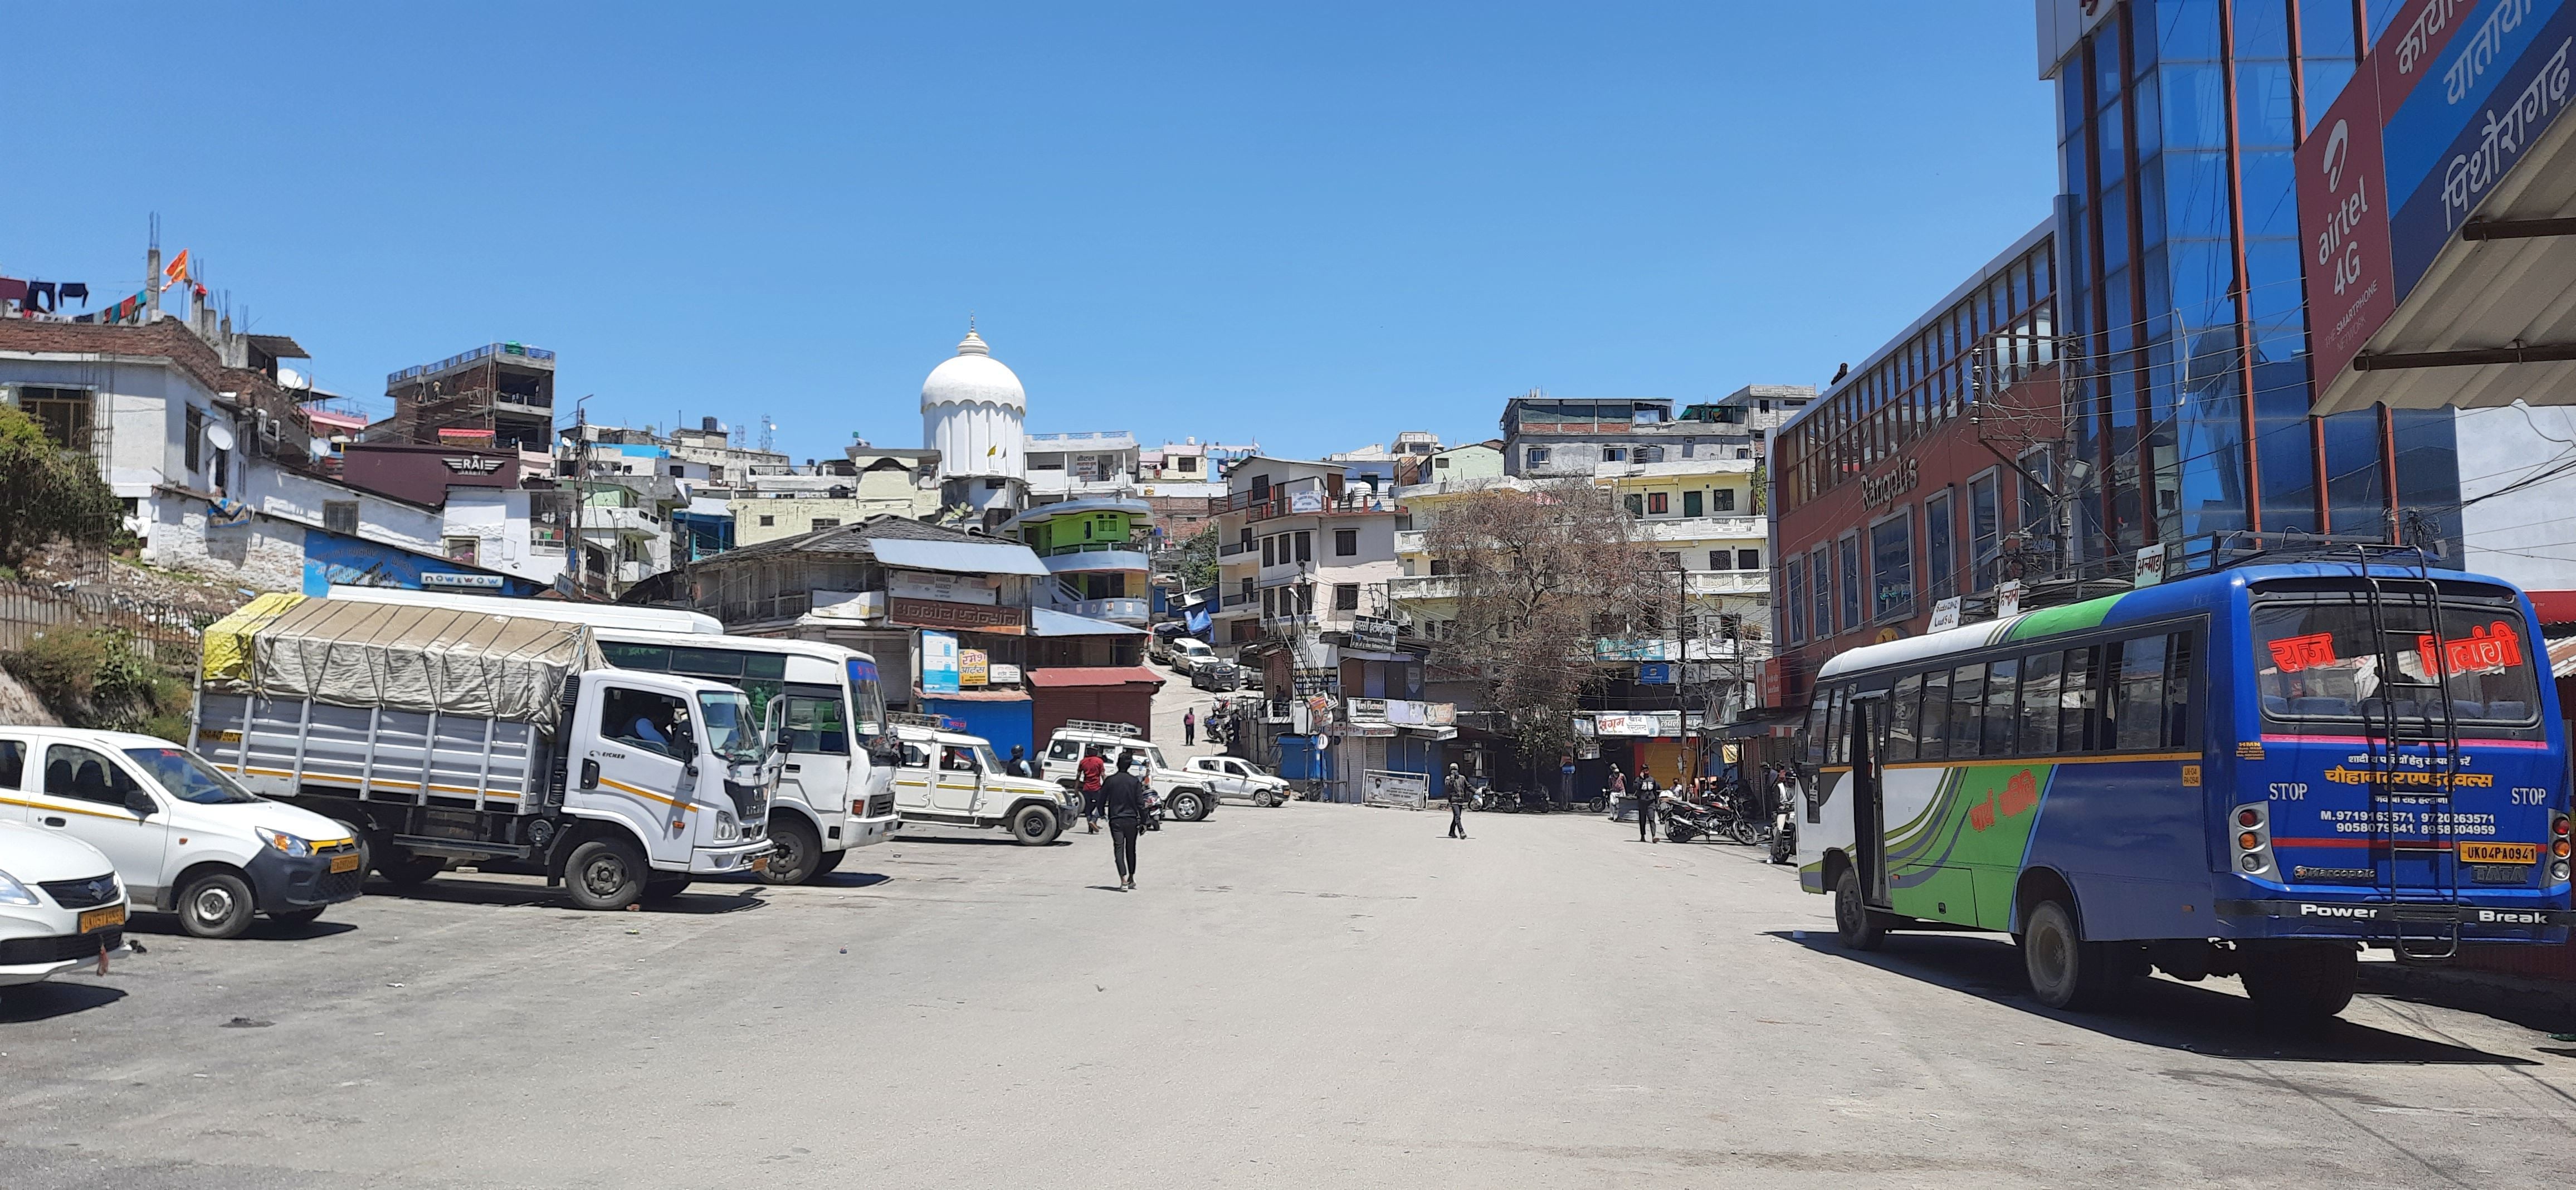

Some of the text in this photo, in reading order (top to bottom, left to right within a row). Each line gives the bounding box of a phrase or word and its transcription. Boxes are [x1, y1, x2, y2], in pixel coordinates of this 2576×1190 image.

[2441, 36, 2573, 232] पिथौरागढ़
[2319, 174, 2368, 266] airtel
[2334, 241, 2361, 296] 4G
[2335, 279, 2378, 335] SMARTPHONE
[2268, 632, 2335, 672] राज
[2348, 753, 2369, 763] शादी
[2269, 783, 2308, 801] STOP
[2511, 787, 2546, 806] STOP
[2472, 865, 2526, 882] TATA
[2301, 904, 2378, 919] Power
[2479, 910, 2549, 925] Break
